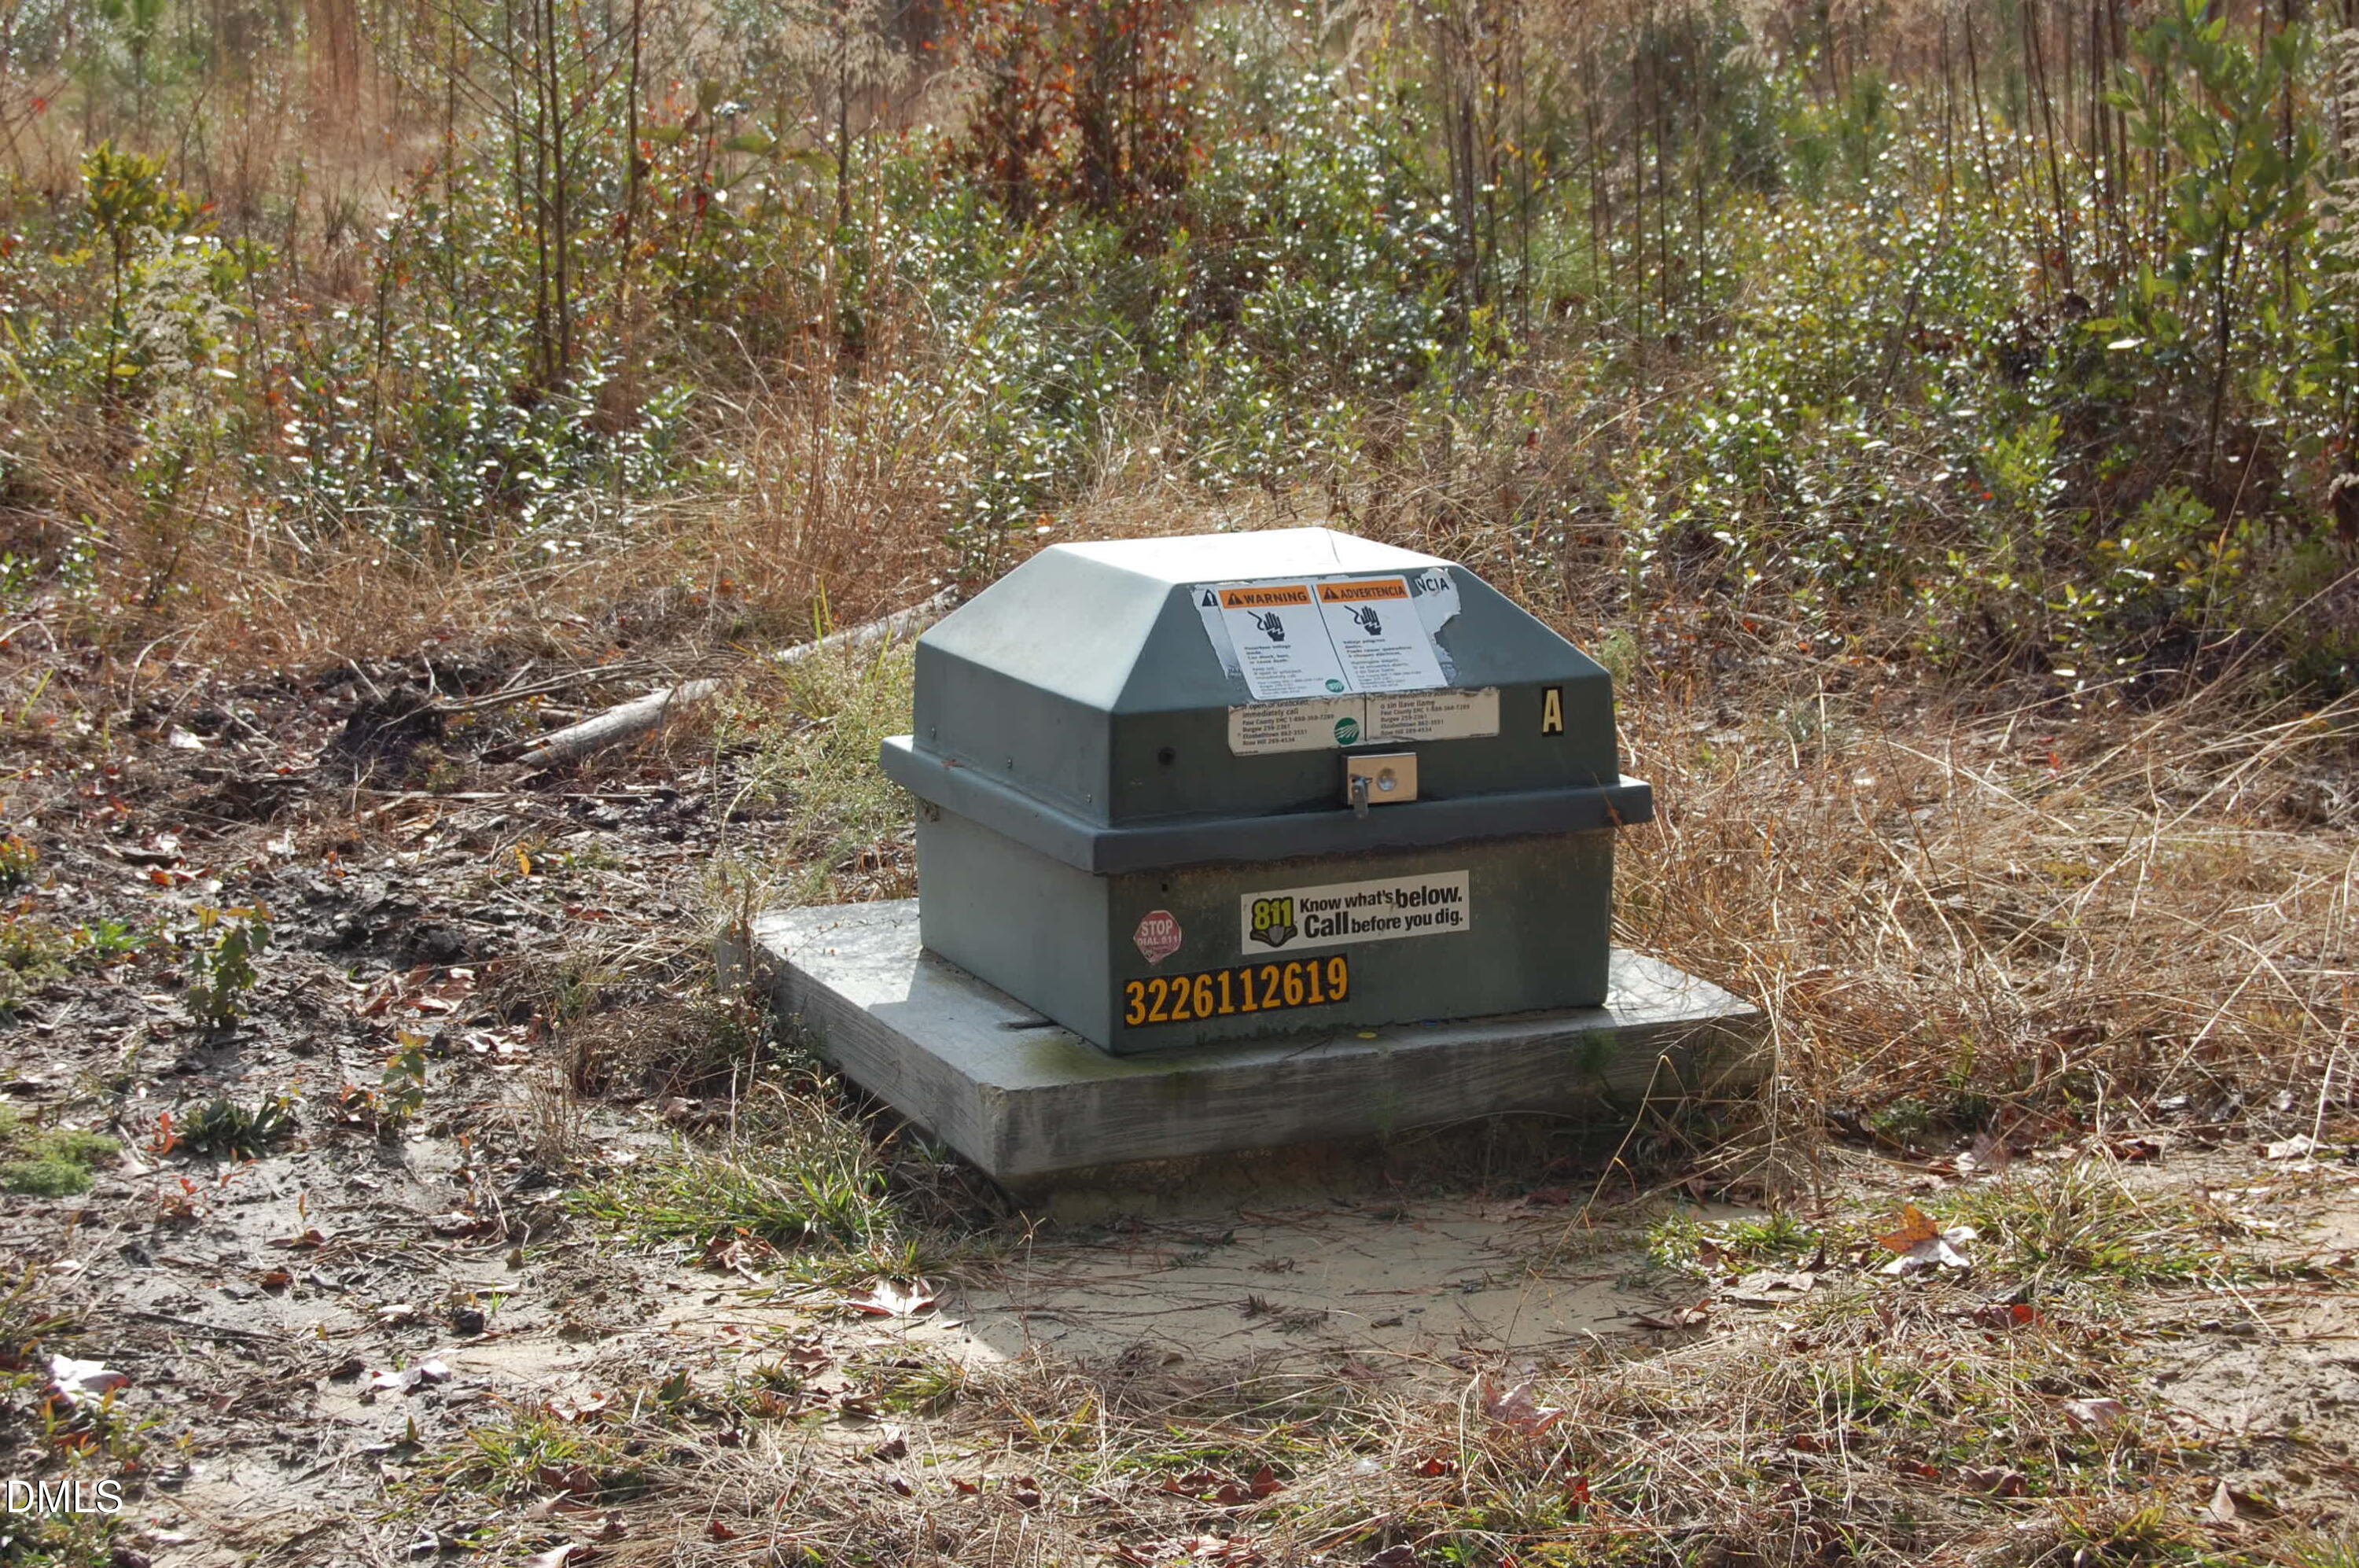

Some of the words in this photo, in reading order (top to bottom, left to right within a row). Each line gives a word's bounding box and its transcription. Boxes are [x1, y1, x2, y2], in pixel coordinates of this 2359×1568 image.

[1244, 591, 1307, 604] WARNING
[1341, 586, 1406, 598] ADVERTENCIA
[1242, 709, 1285, 719] immediately
[1542, 690, 1563, 733] A
[1300, 897, 1341, 913] Know
[1344, 889, 1393, 908] what's
[1395, 885, 1463, 908] below.
[1253, 897, 1294, 930] 811
[1305, 911, 1349, 938] Call
[1351, 915, 1401, 933] before
[1404, 912, 1432, 931] you
[1435, 908, 1463, 926] dig.
[1141, 919, 1173, 937] STOP
[1137, 937, 1158, 946] DIAL
[1125, 957, 1348, 1025] 3226112619
